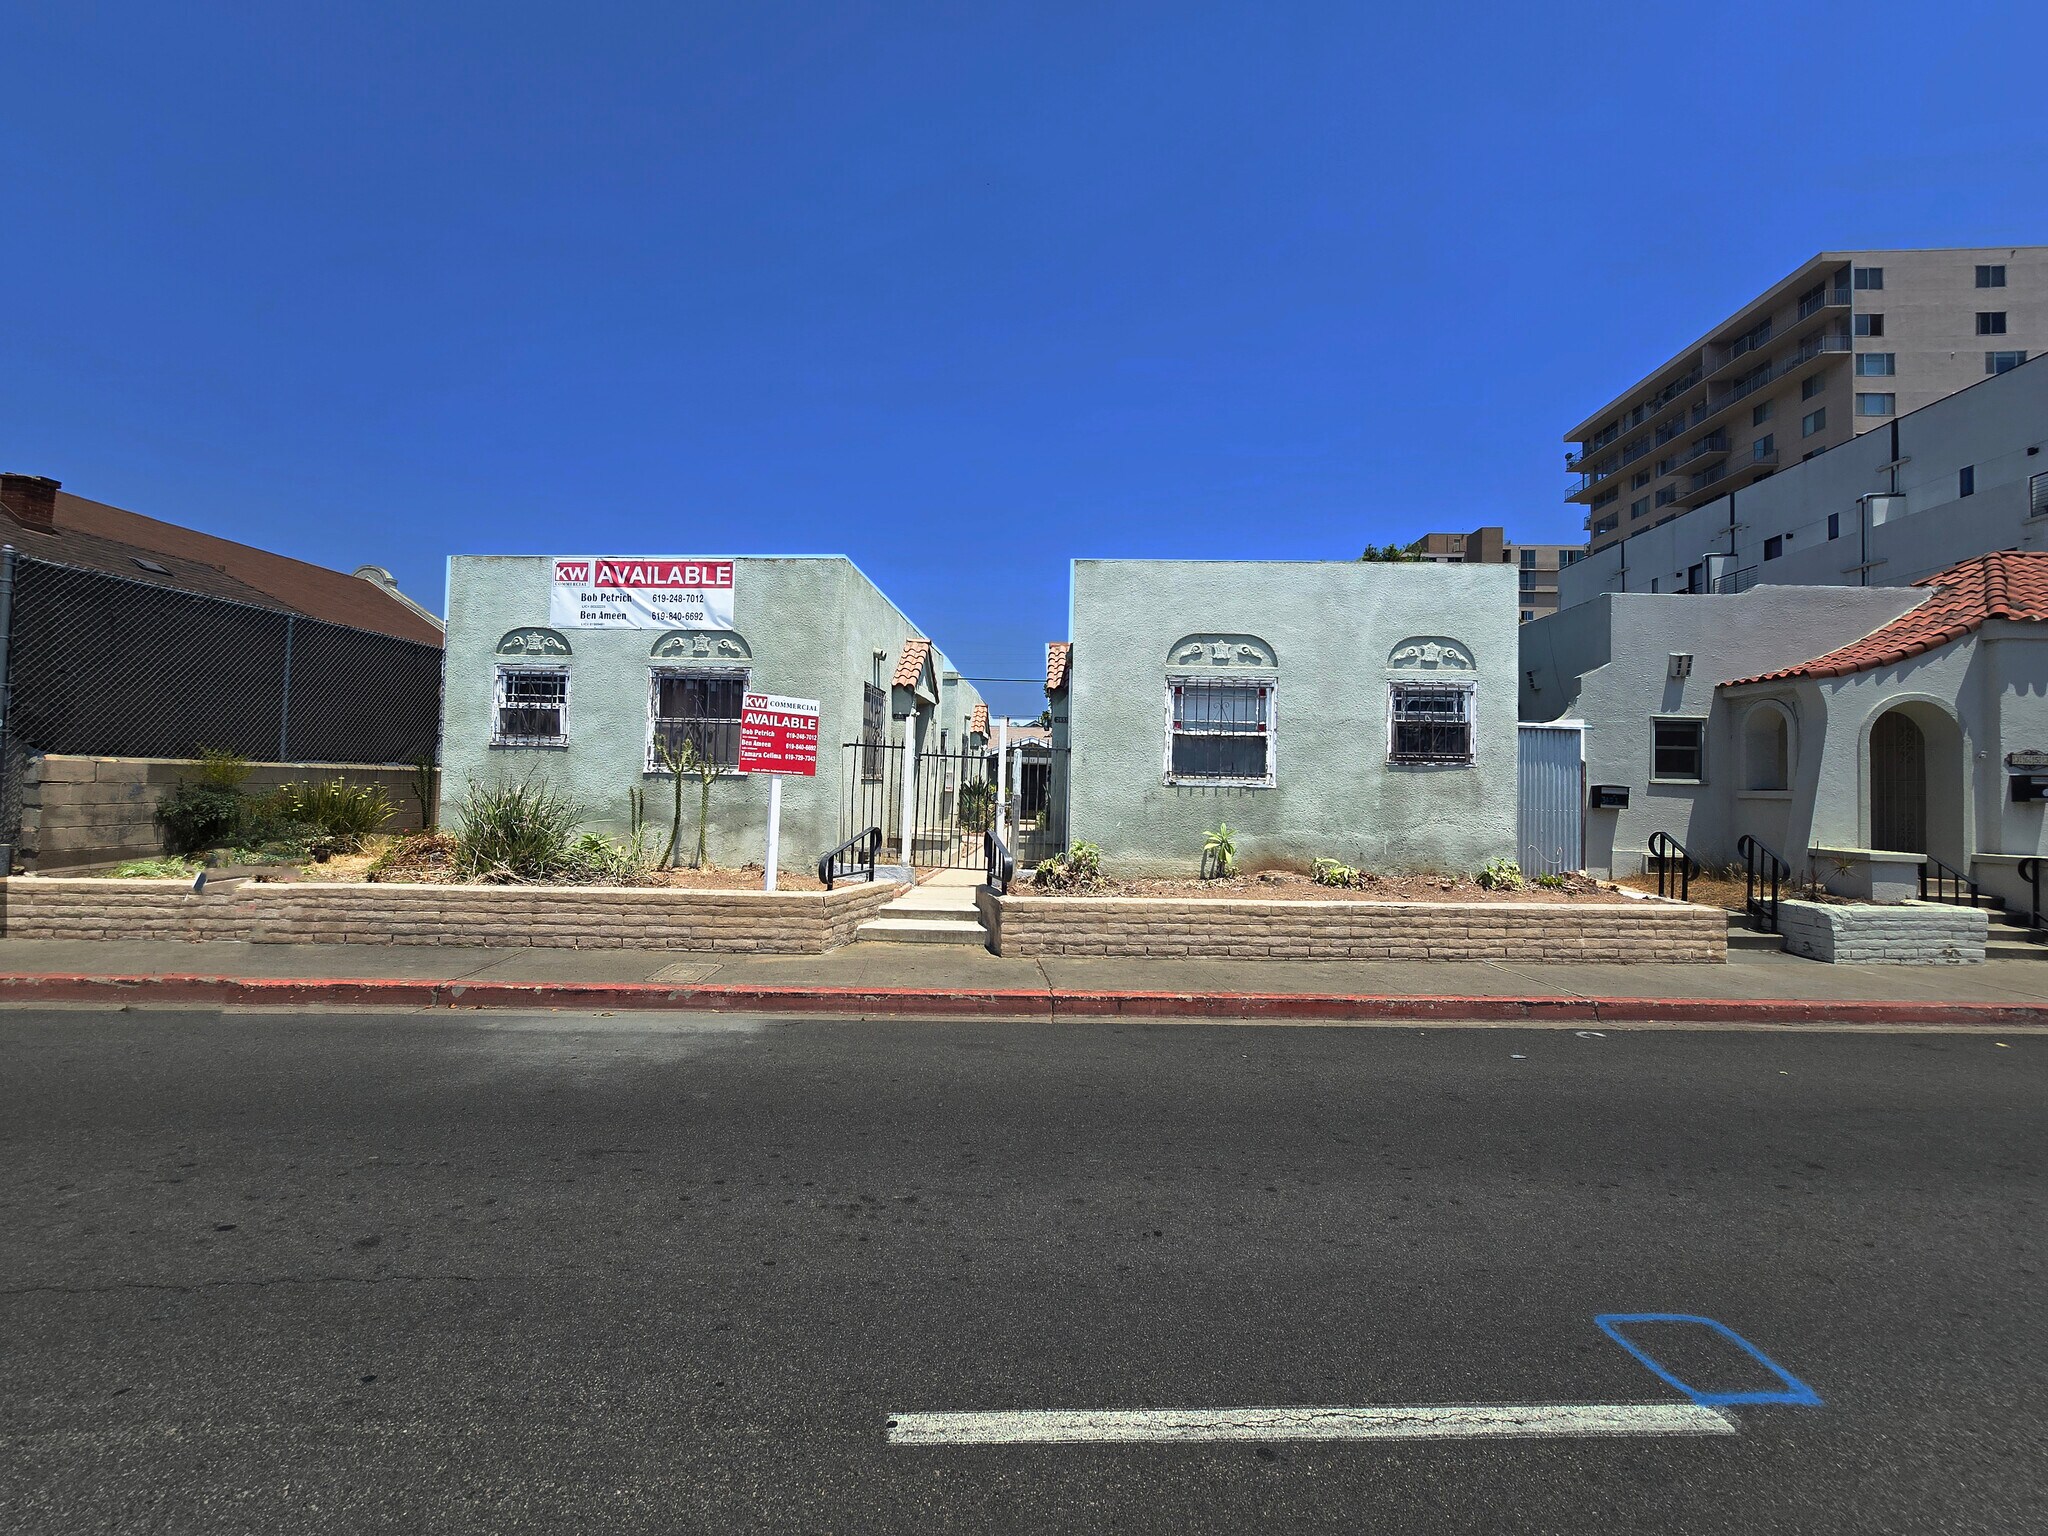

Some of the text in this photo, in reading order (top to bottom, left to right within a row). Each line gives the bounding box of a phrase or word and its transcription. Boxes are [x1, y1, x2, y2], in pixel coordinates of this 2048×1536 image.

[555, 566, 588, 581] KW
[596, 565, 731, 585] AVAILABLE
[580, 592, 704, 603] Bob Petrich 619-248-7012
[580, 610, 704, 621] Ben Ameen 619-840-6692
[745, 696, 818, 711] KW COMMERCIAL
[745, 713, 816, 729] AVAILABLE
[754, 729, 775, 737] Petrich
[752, 740, 771, 748] Ameen
[741, 750, 762, 758] Tamara
